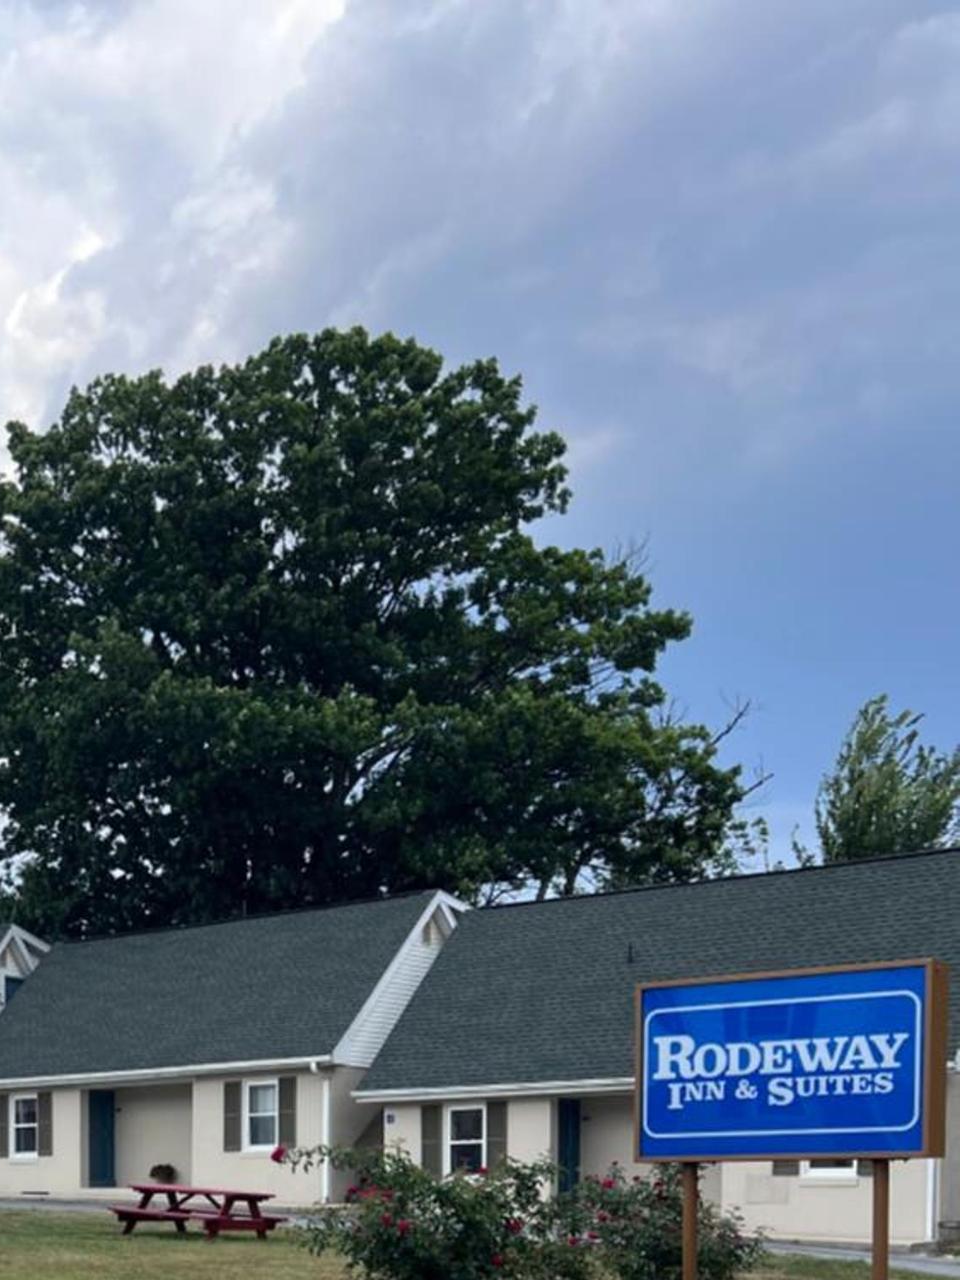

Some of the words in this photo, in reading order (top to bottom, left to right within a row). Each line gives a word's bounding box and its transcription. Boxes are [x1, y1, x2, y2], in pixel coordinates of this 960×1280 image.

[652, 1033, 909, 1080] RODEWAY
[667, 1081, 725, 1110] INN
[735, 1079, 758, 1100] &
[768, 1072, 894, 1106] SUITES
